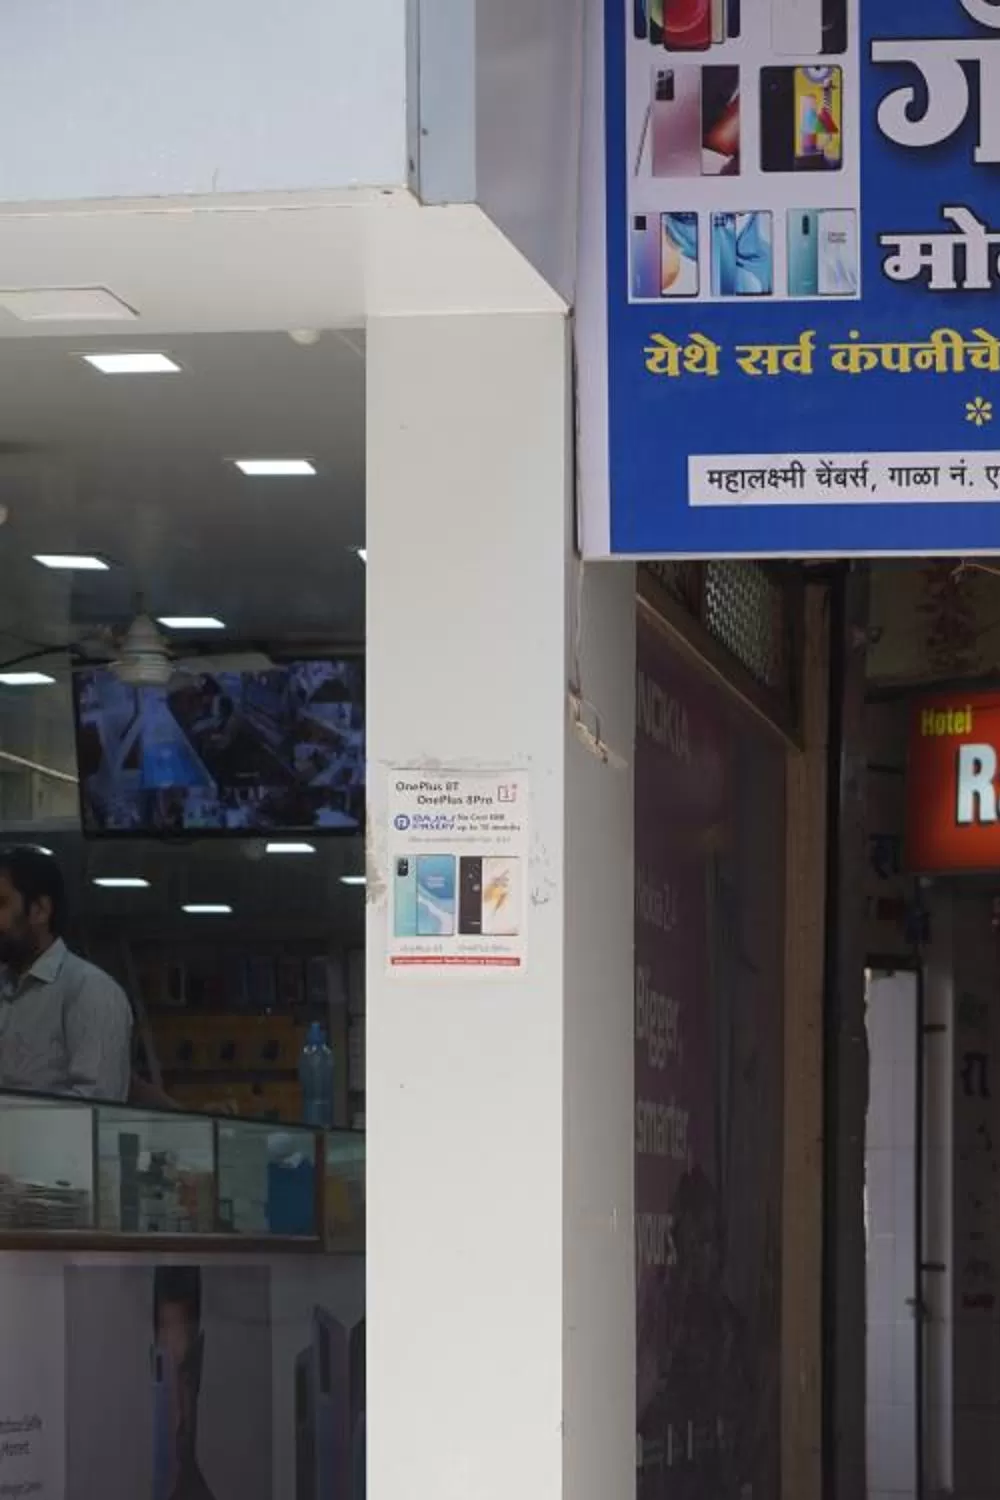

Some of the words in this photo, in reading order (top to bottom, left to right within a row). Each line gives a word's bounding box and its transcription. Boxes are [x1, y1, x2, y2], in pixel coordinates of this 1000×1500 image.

[643, 333, 722, 377] येथे
[736, 330, 817, 374] सर्व
[706, 459, 806, 493] महालक्ष्मी
[888, 465, 940, 488] गाळा
[949, 459, 975, 487] नं.
[921, 704, 973, 737] Hotel
[395, 781, 443, 792] OnePlus
[417, 794, 463, 805] OnePlus
